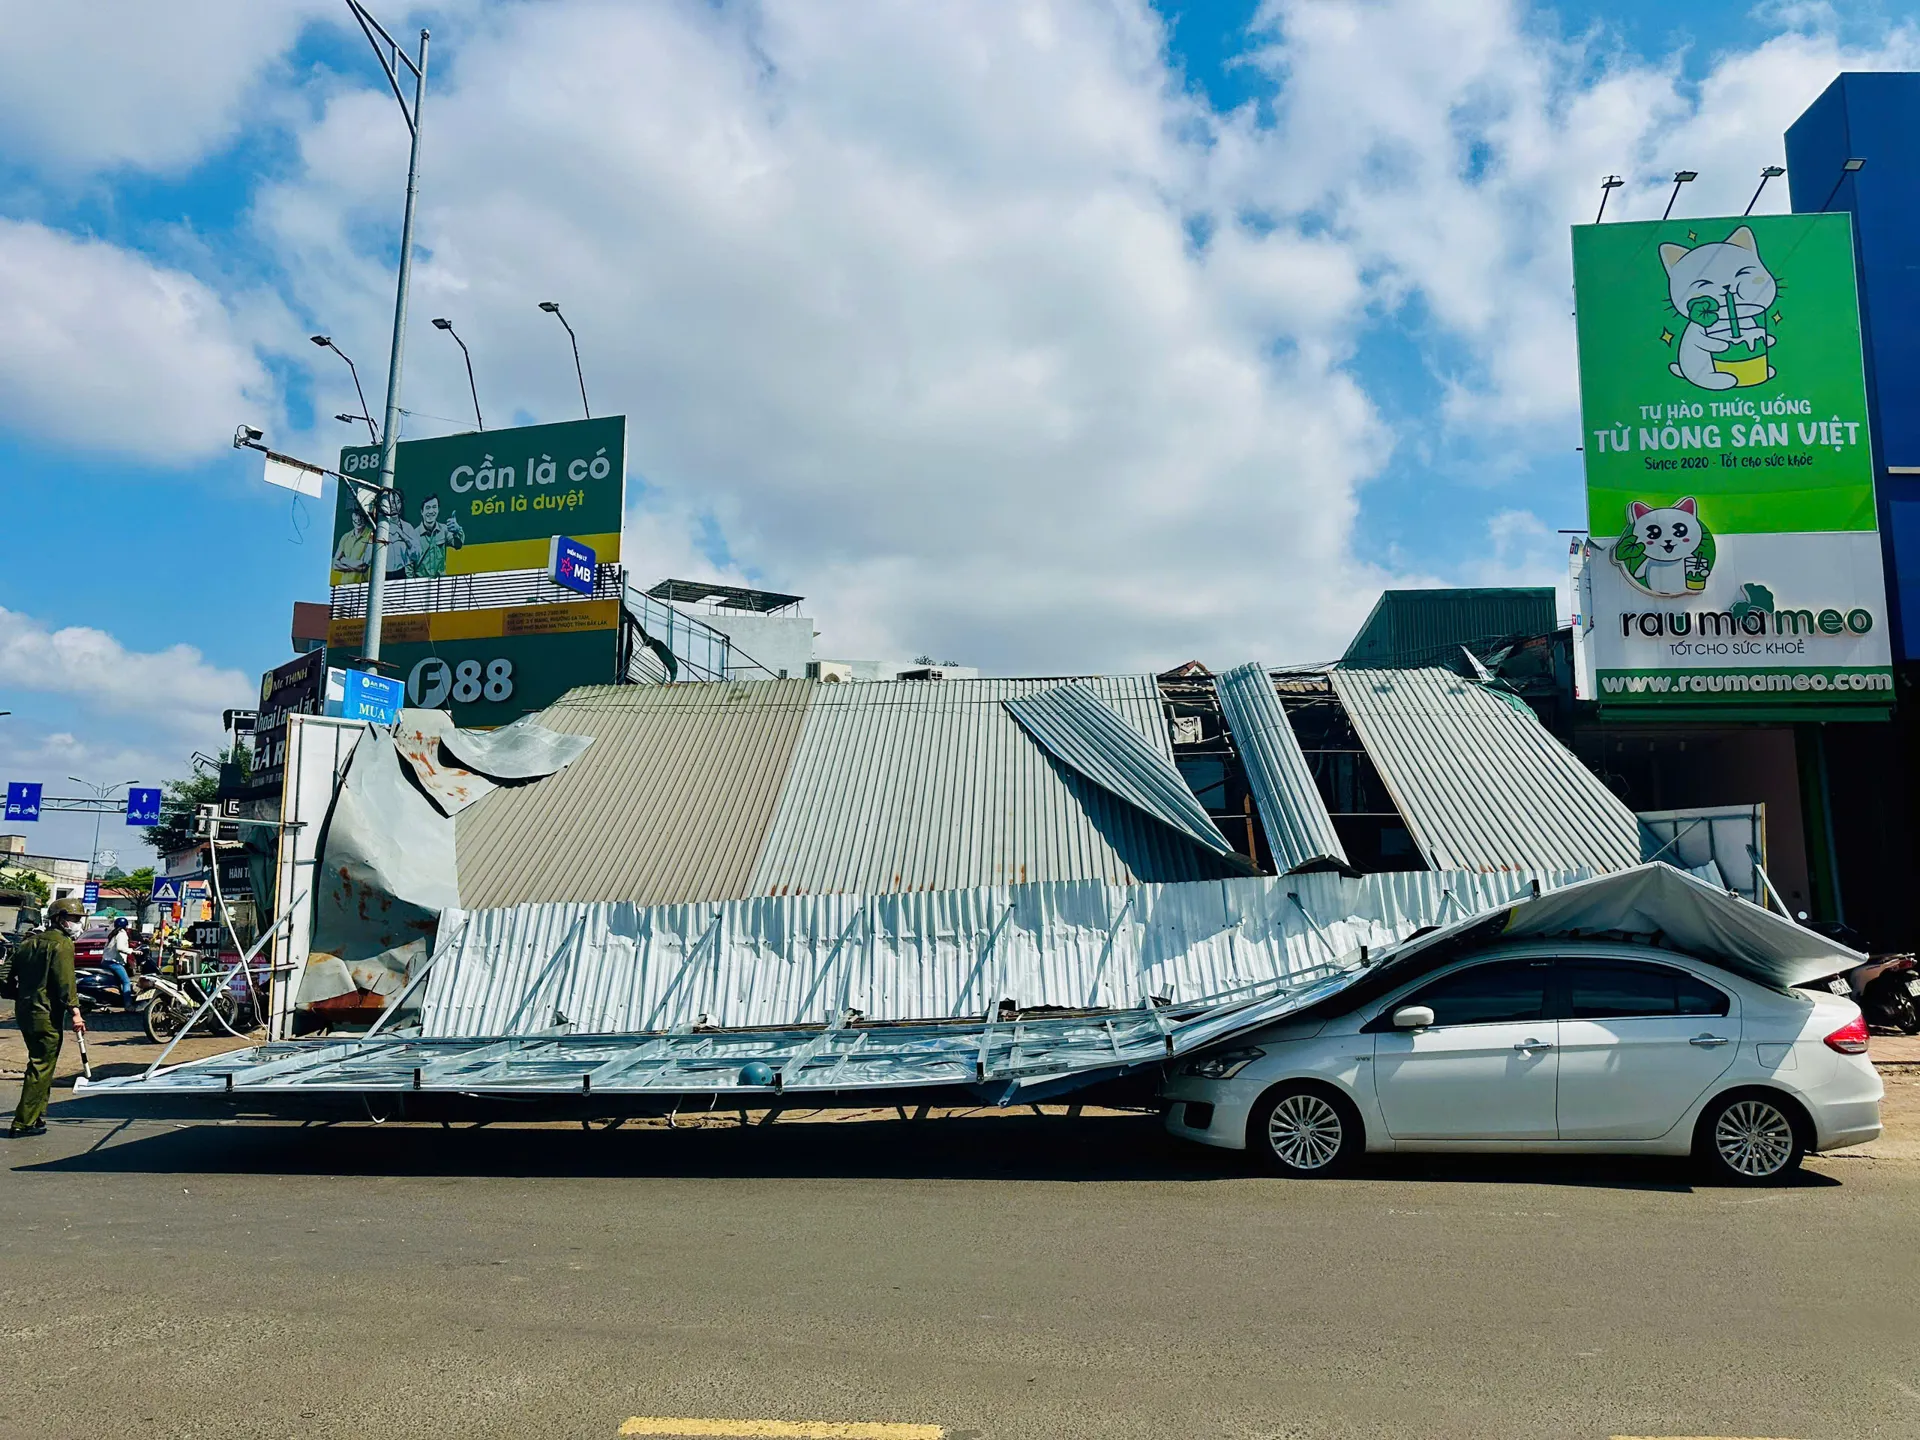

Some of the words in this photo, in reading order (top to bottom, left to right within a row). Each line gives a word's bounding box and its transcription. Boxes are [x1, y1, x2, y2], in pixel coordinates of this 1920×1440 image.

[1639, 404, 1661, 420] TỰ
[1667, 397, 1704, 420] HÀO
[1709, 397, 1755, 418] THỨC
[1760, 393, 1812, 416] UỐNG
[1594, 421, 1631, 453] TỪ
[1639, 420, 1721, 450] NÔNG
[1730, 414, 1789, 448] SẢN
[1797, 416, 1860, 452] VIỆT
[450, 453, 515, 493] Cần
[526, 453, 556, 485] là
[567, 447, 611, 482] có
[1645, 457, 1678, 471] Since
[1680, 456, 1709, 469] 2020
[1719, 452, 1737, 469] Tốt
[1741, 454, 1762, 469] cho
[1764, 453, 1785, 468] sức
[471, 494, 505, 516] Đến
[510, 492, 527, 512] là
[533, 489, 584, 514] duyệt
[574, 563, 590, 583] MB
[1669, 641, 1692, 656] TỐT
[1694, 643, 1729, 656] CHO
[1732, 640, 1763, 655] SỨC
[1601, 673, 1893, 694] www.raumameo.com
[359, 702, 386, 720] MUA
